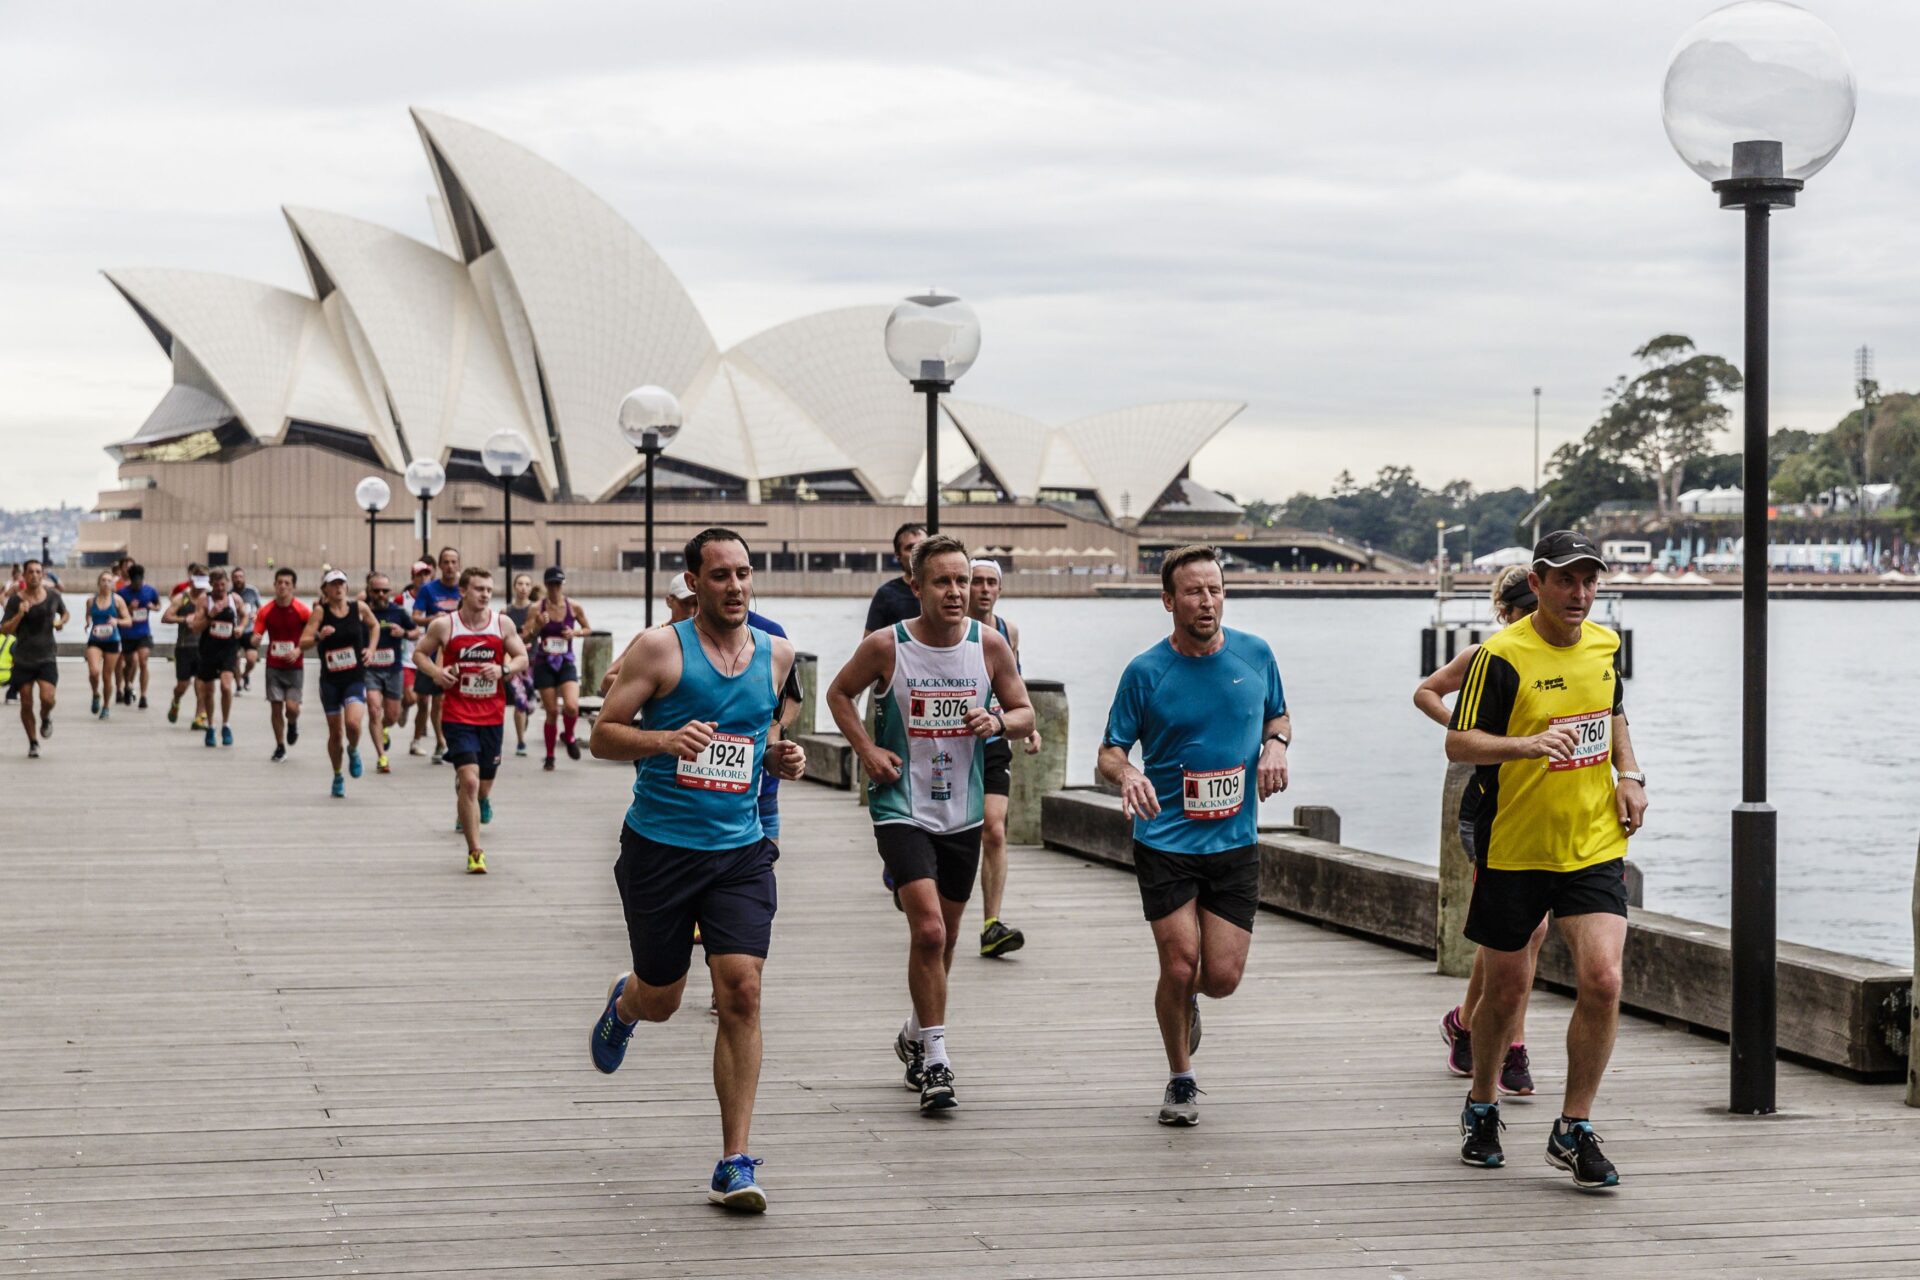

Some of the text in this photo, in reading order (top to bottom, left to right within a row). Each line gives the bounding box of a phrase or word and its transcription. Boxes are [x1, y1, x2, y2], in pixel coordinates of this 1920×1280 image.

[460, 641, 495, 659] VISION
[907, 678, 977, 688] BLACKMORES
[913, 699, 923, 716] A
[932, 698, 969, 718] 3076
[913, 719, 964, 727] BLACKMOR
[1575, 719, 1605, 744] 760
[709, 743, 745, 768] 1924
[1576, 743, 1607, 755] KMORES
[682, 764, 747, 779] BLACKMORES
[1187, 780, 1198, 798] A
[1207, 775, 1239, 798] 1709
[1188, 795, 1242, 808] BLACKMORES
